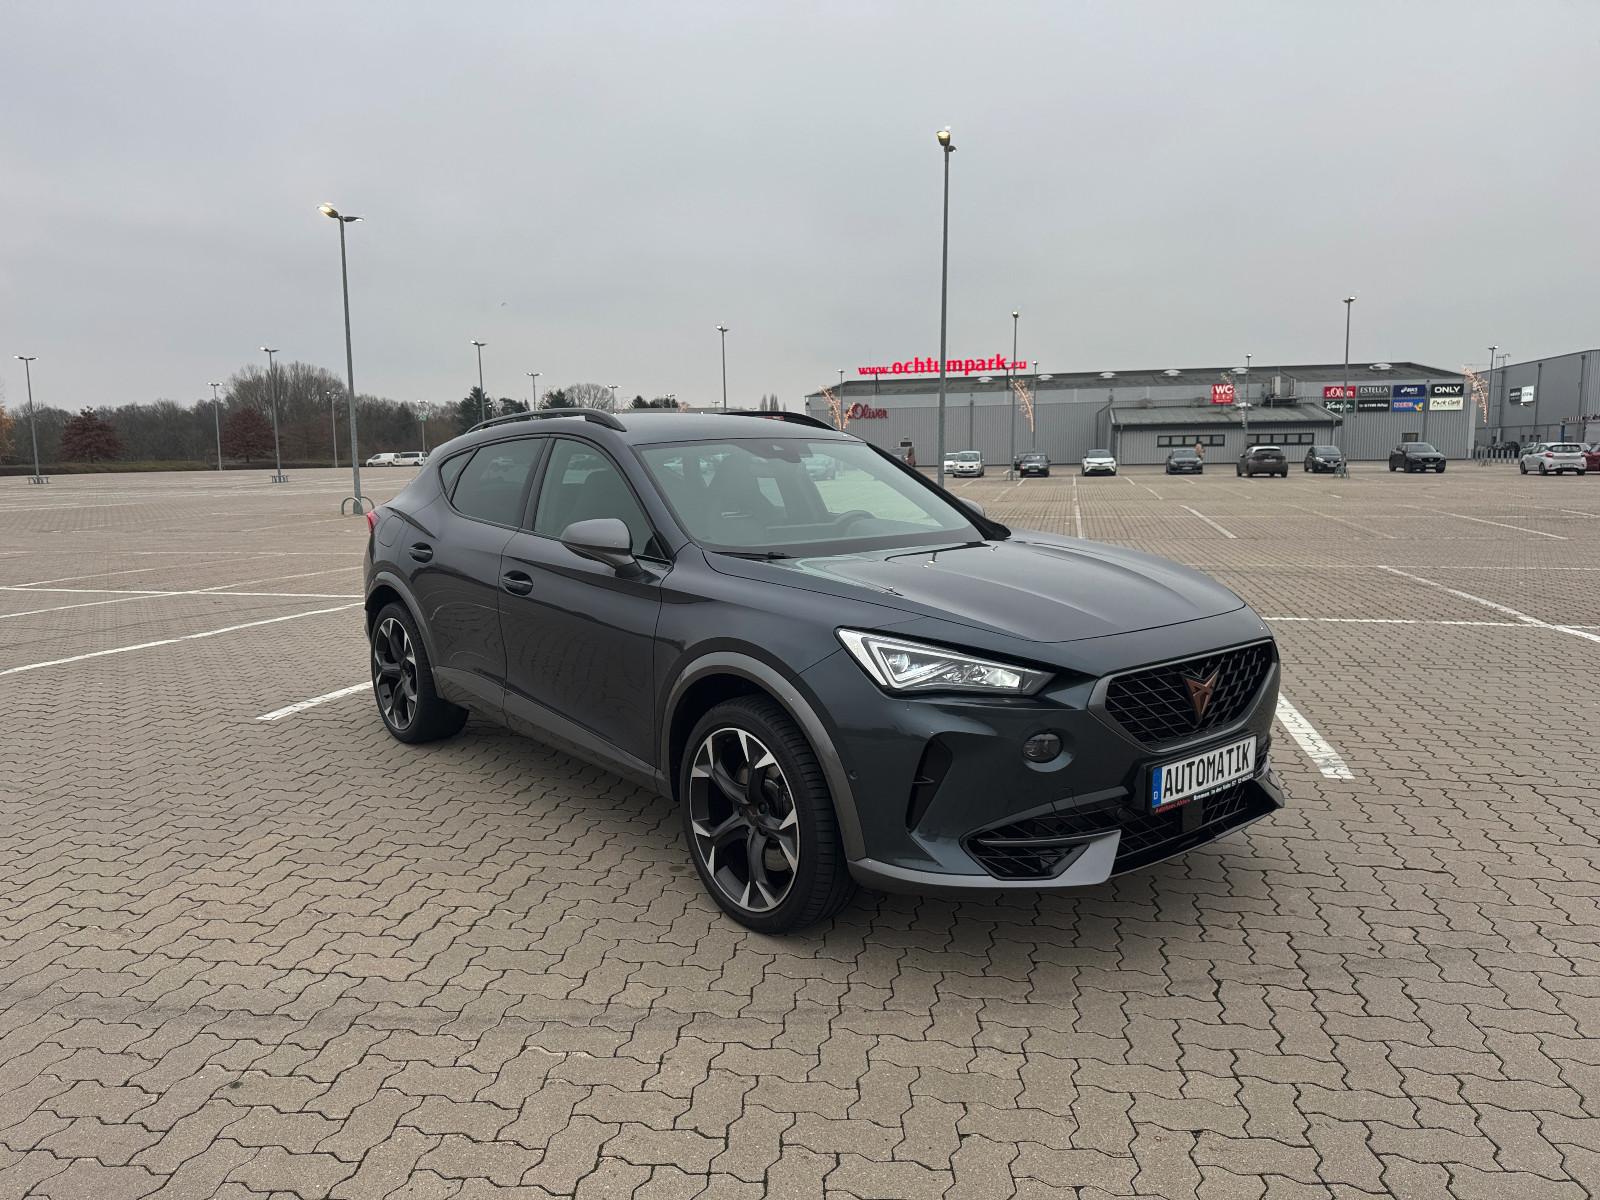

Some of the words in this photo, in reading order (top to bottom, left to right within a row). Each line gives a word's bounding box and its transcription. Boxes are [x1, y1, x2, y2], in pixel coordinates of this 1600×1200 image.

[1215, 385, 1234, 394] WC
[1326, 387, 1354, 397] s.Olier
[1434, 386, 1461, 394] ONLY
[1163, 742, 1250, 798] AUTOMATIK
[1153, 791, 1159, 800] D
